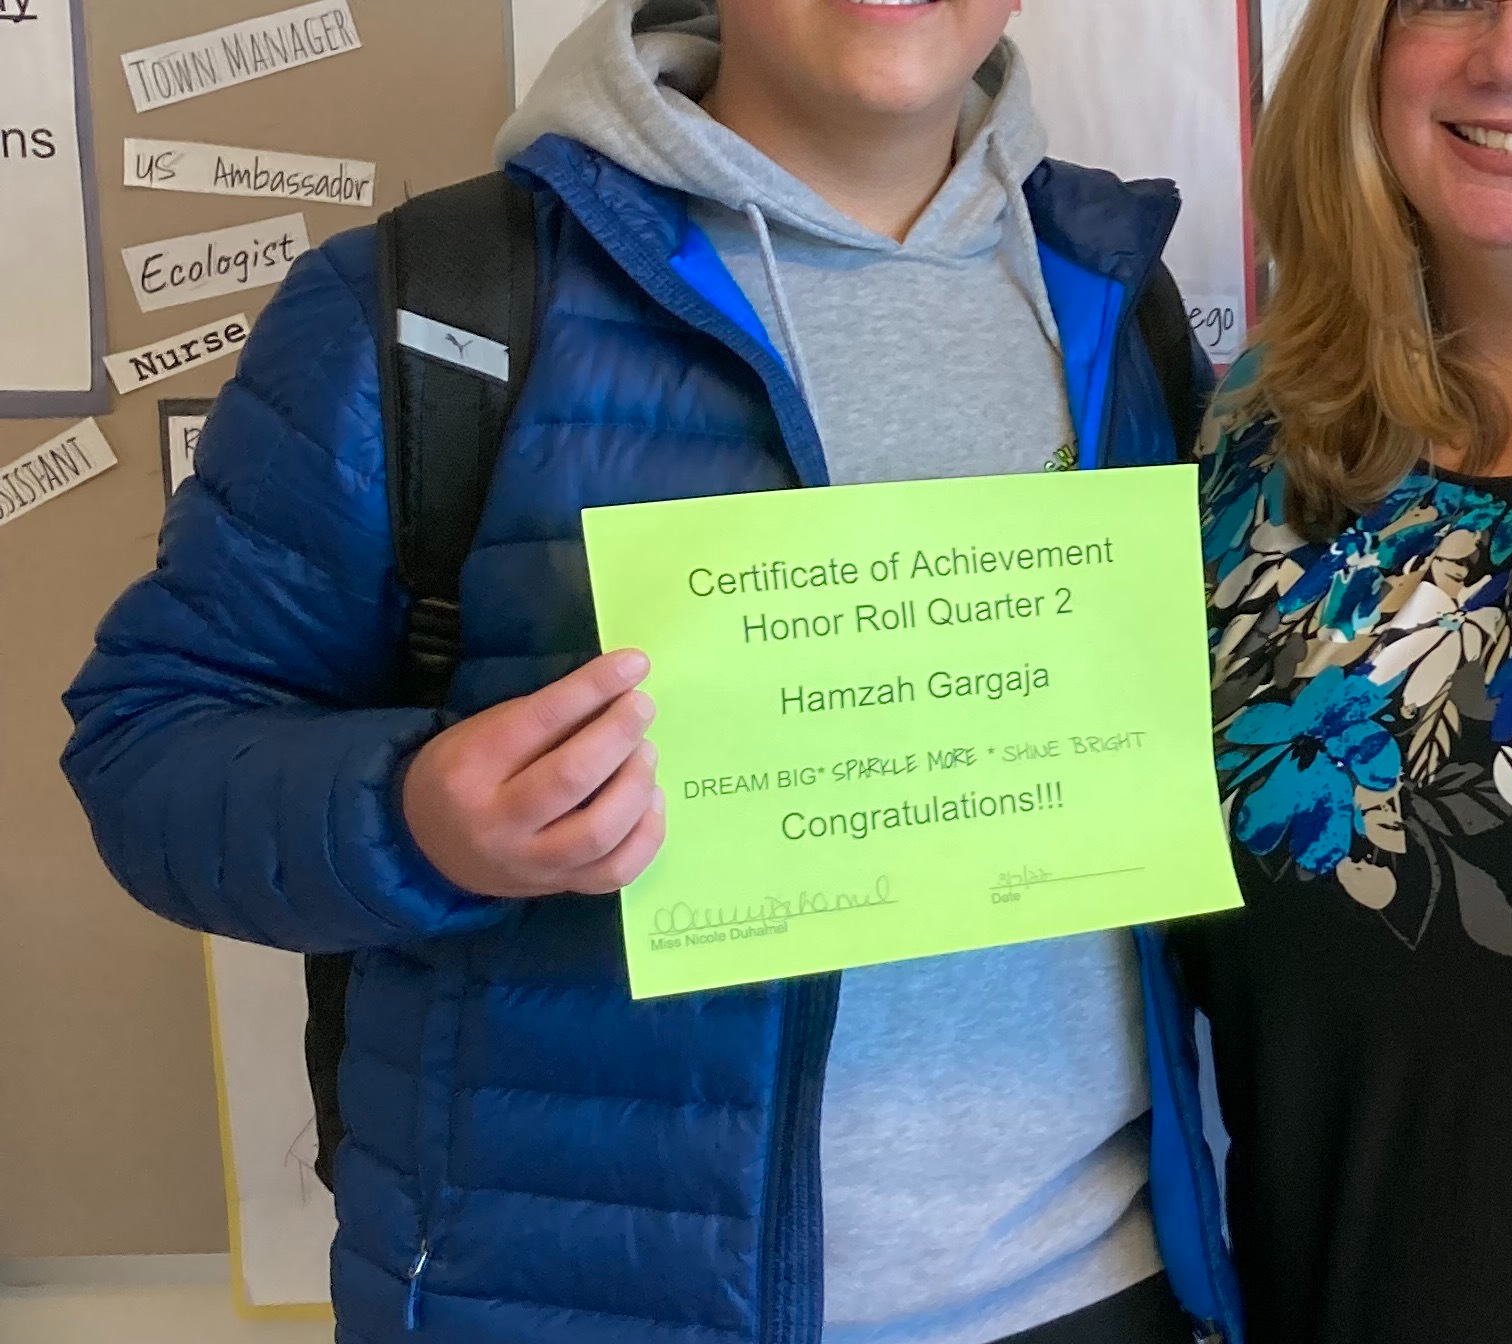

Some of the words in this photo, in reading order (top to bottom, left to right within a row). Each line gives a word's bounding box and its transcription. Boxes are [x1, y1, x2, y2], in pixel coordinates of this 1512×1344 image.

[129, 47, 218, 103] TOWN
[221, 8, 357, 78] MANAGER
[136, 151, 176, 185] US
[213, 156, 370, 202] Ambassador
[141, 234, 294, 294] Ecologist
[129, 321, 247, 382] Nurse
[688, 557, 858, 598] Certificate
[870, 552, 900, 582] of
[910, 537, 1114, 579] Achievement
[742, 607, 843, 644] Honor
[855, 600, 916, 633] Roll
[927, 591, 1045, 627] Quarter
[1054, 587, 1073, 616] 2
[780, 675, 915, 716] Hamzah
[927, 663, 1051, 702] Gargaja
[684, 772, 769, 799] DREAM
[832, 754, 918, 782] SPARKLE
[927, 747, 977, 772] MORE
[1002, 740, 1062, 763] SHINE
[1068, 731, 1146, 755] BRIGHT
[781, 781, 1064, 840] Congratulations!!!
[991, 891, 1021, 905] Date
[650, 936, 681, 951] Miss
[685, 930, 726, 946] Nicole
[730, 922, 789, 940] Duhamel
